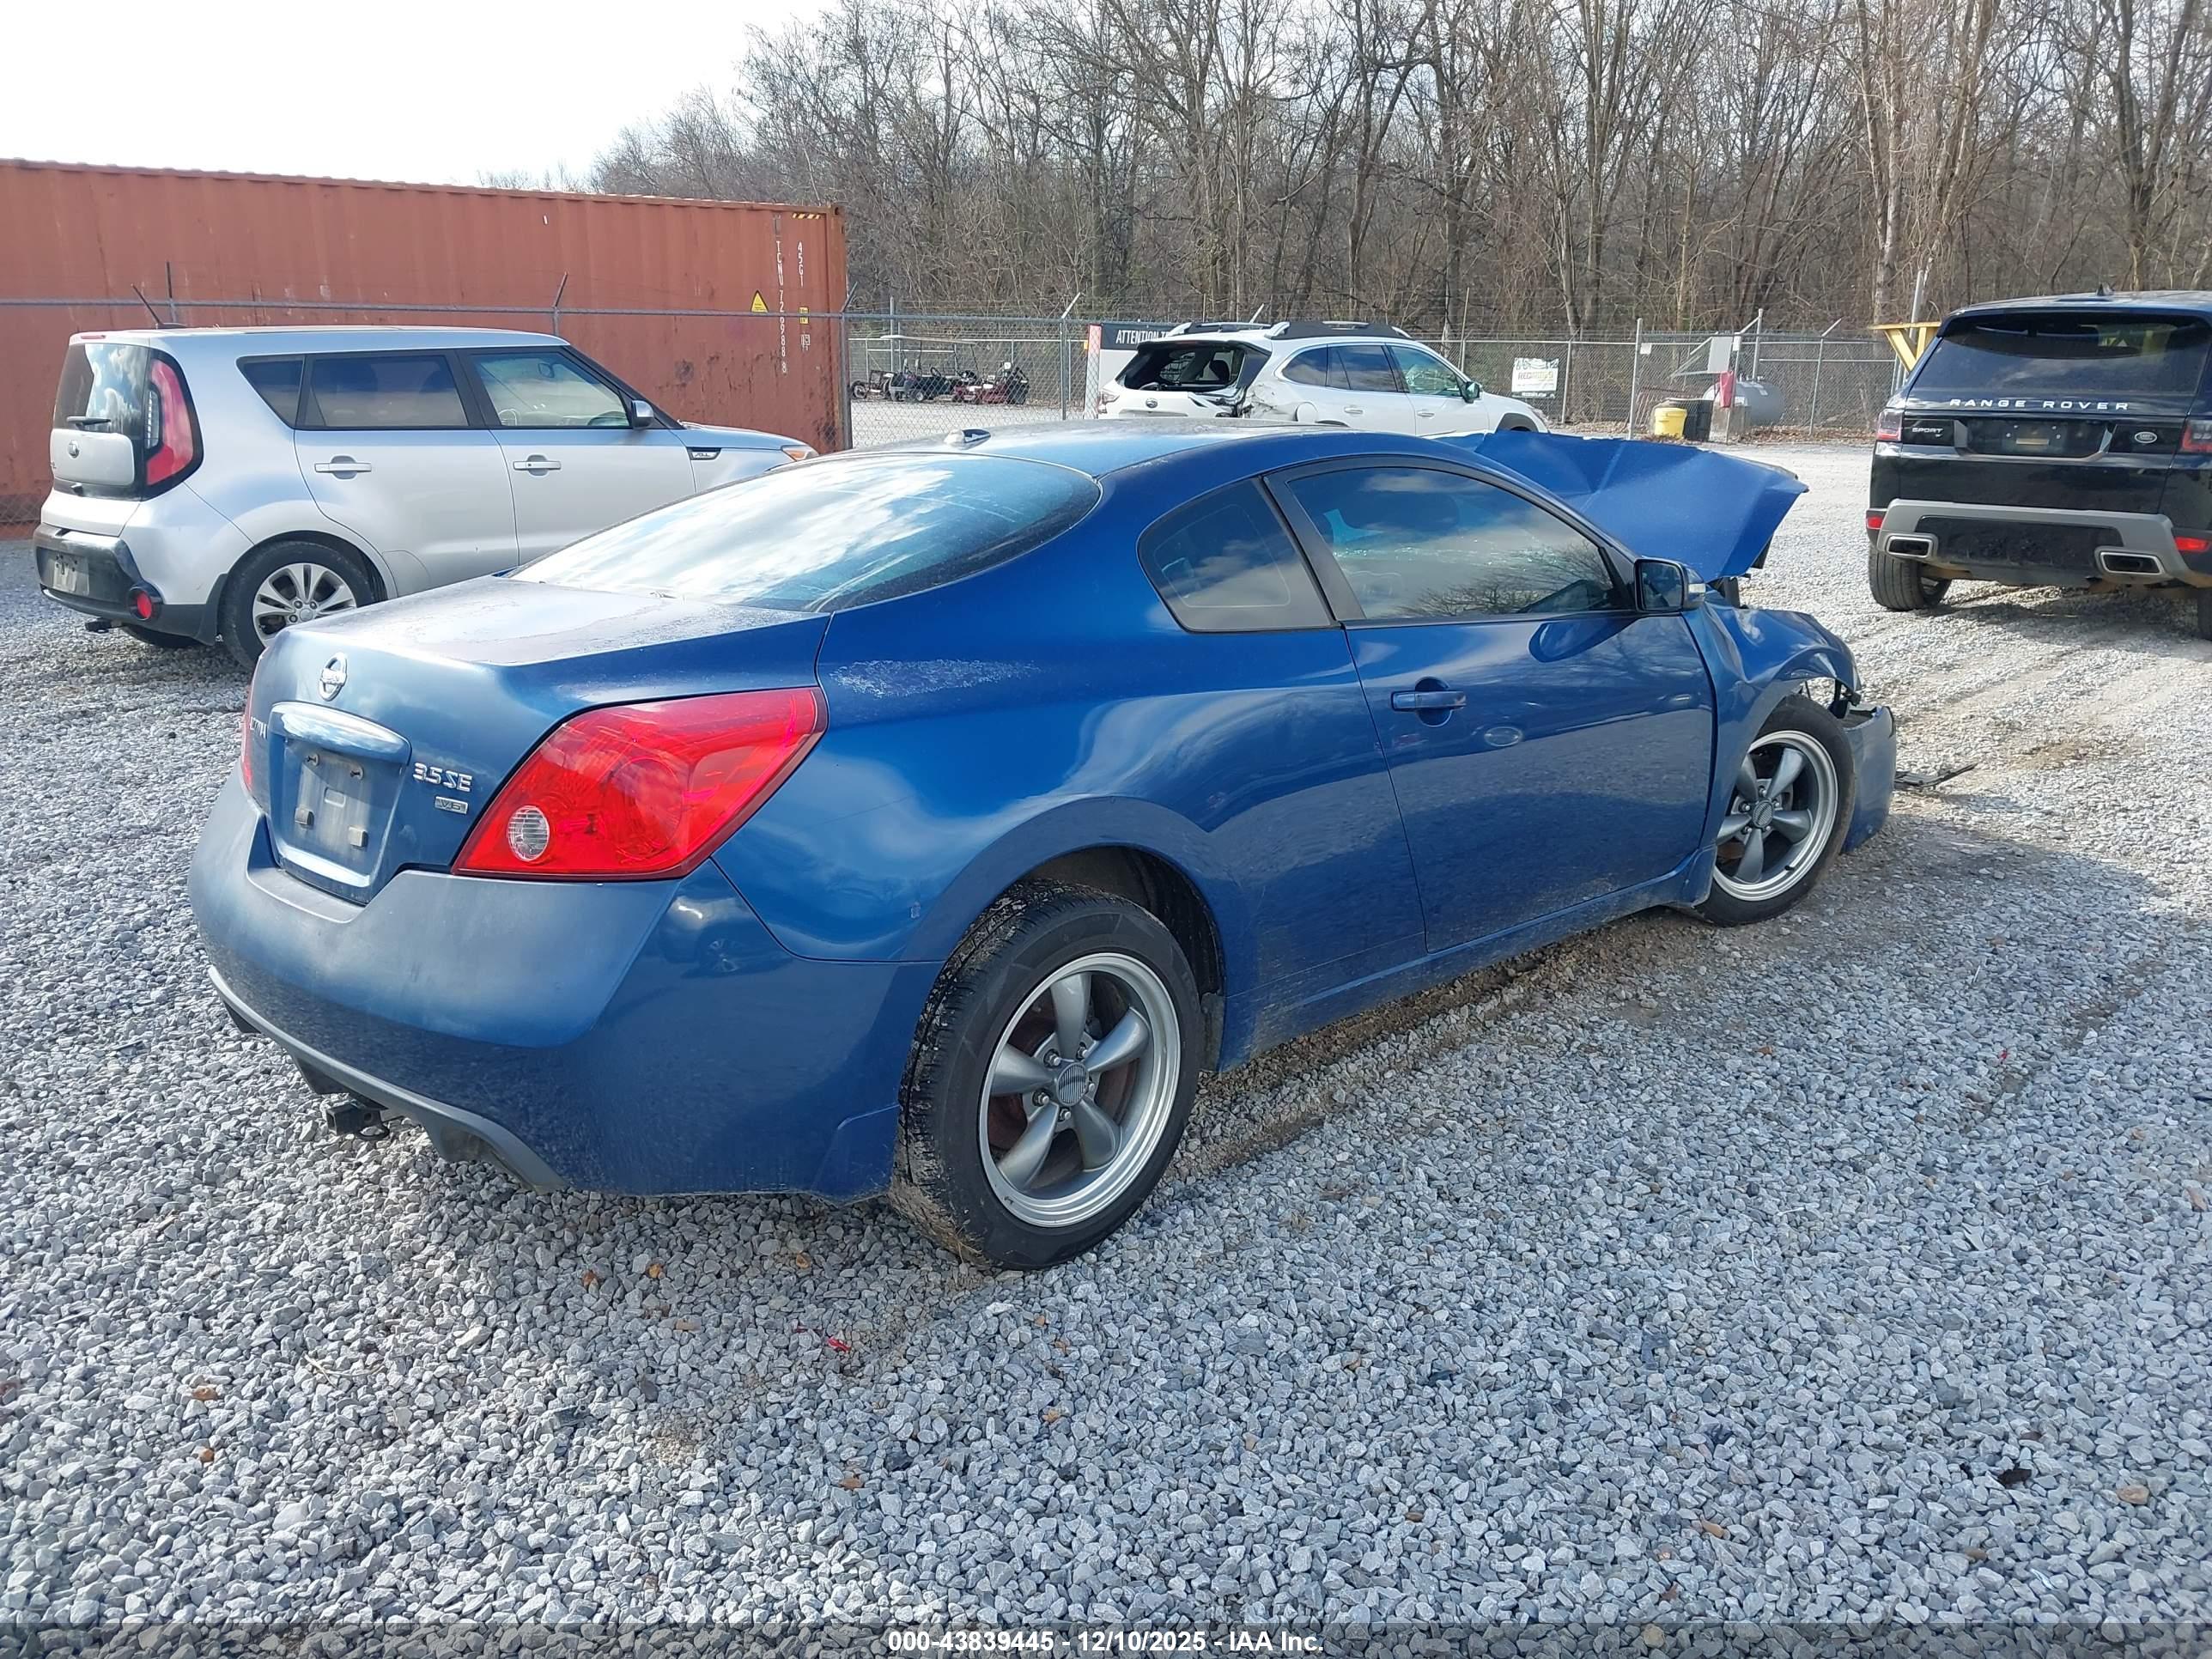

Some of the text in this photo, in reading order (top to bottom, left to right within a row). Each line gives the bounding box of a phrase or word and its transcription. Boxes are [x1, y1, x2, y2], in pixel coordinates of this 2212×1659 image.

[775, 240, 784, 286] TCNU
[1115, 330, 1158, 344] ATTENTION
[1949, 398, 2129, 410] RANGE ROVER
